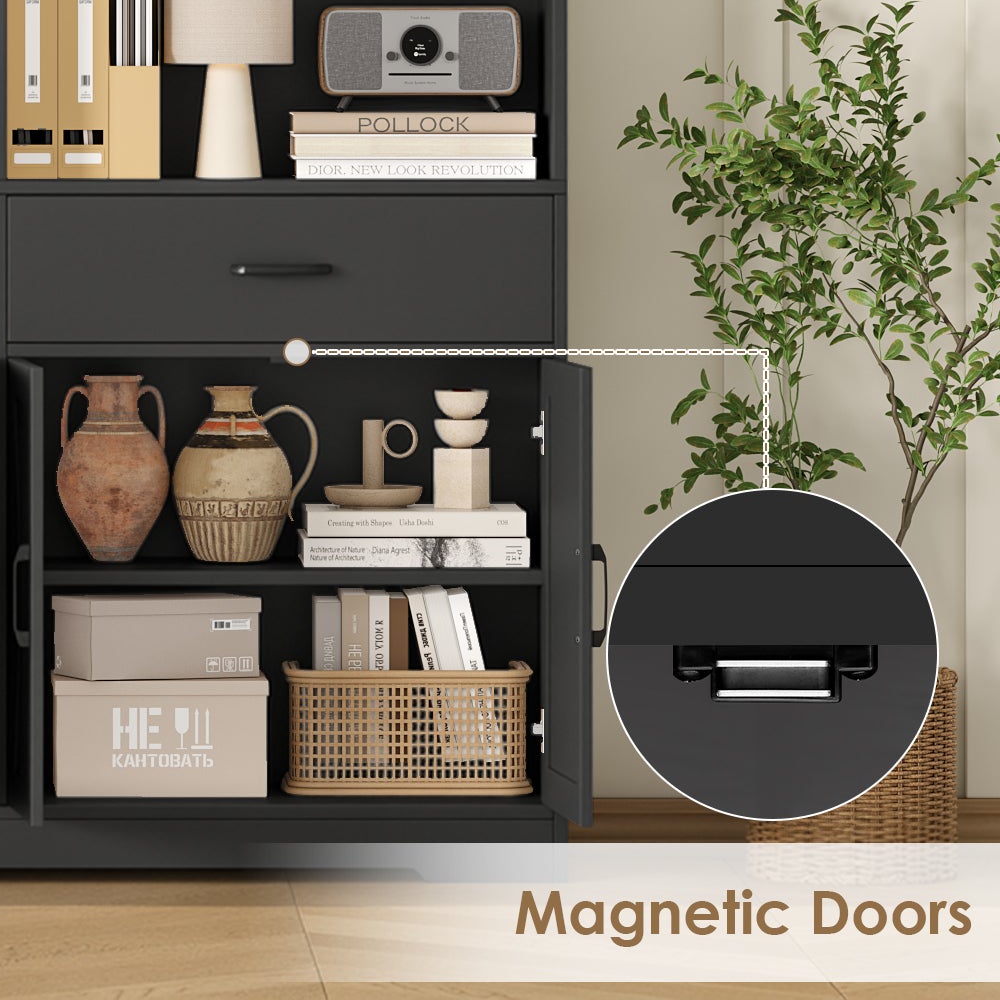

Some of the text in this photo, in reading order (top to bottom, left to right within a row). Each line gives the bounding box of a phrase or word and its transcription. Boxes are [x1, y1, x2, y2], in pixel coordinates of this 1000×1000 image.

[358, 116, 469, 133] POLLOCK
[308, 164, 524, 176] DIOR. NEW LOOK REVOLUTION
[372, 546, 390, 554] Diana
[391, 546, 410, 555] Agrest
[112, 707, 163, 750] НЕ
[111, 753, 214, 768] КАНТОВАТЬ
